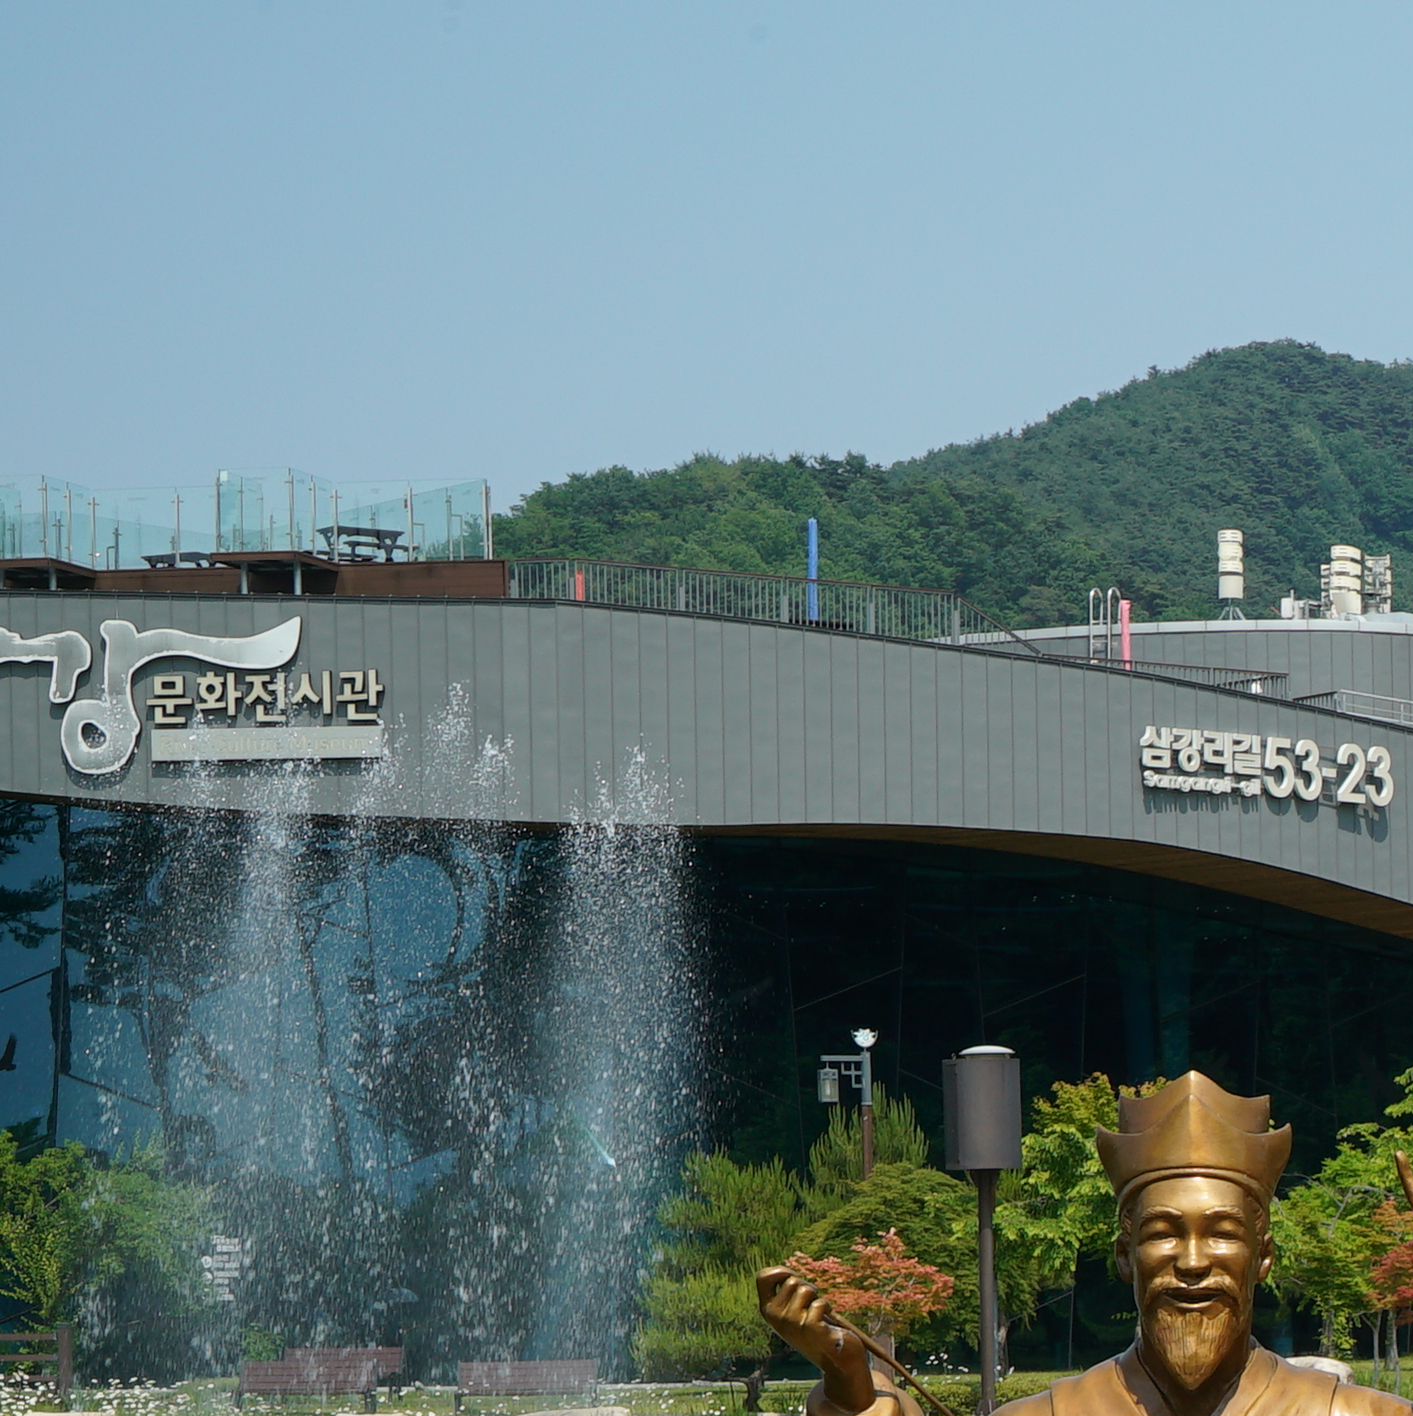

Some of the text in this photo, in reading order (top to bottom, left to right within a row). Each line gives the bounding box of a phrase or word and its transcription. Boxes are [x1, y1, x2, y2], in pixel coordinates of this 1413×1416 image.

[146, 668, 384, 724] 문화전시관
[1140, 725, 1395, 807] 삼강리길 53-23
